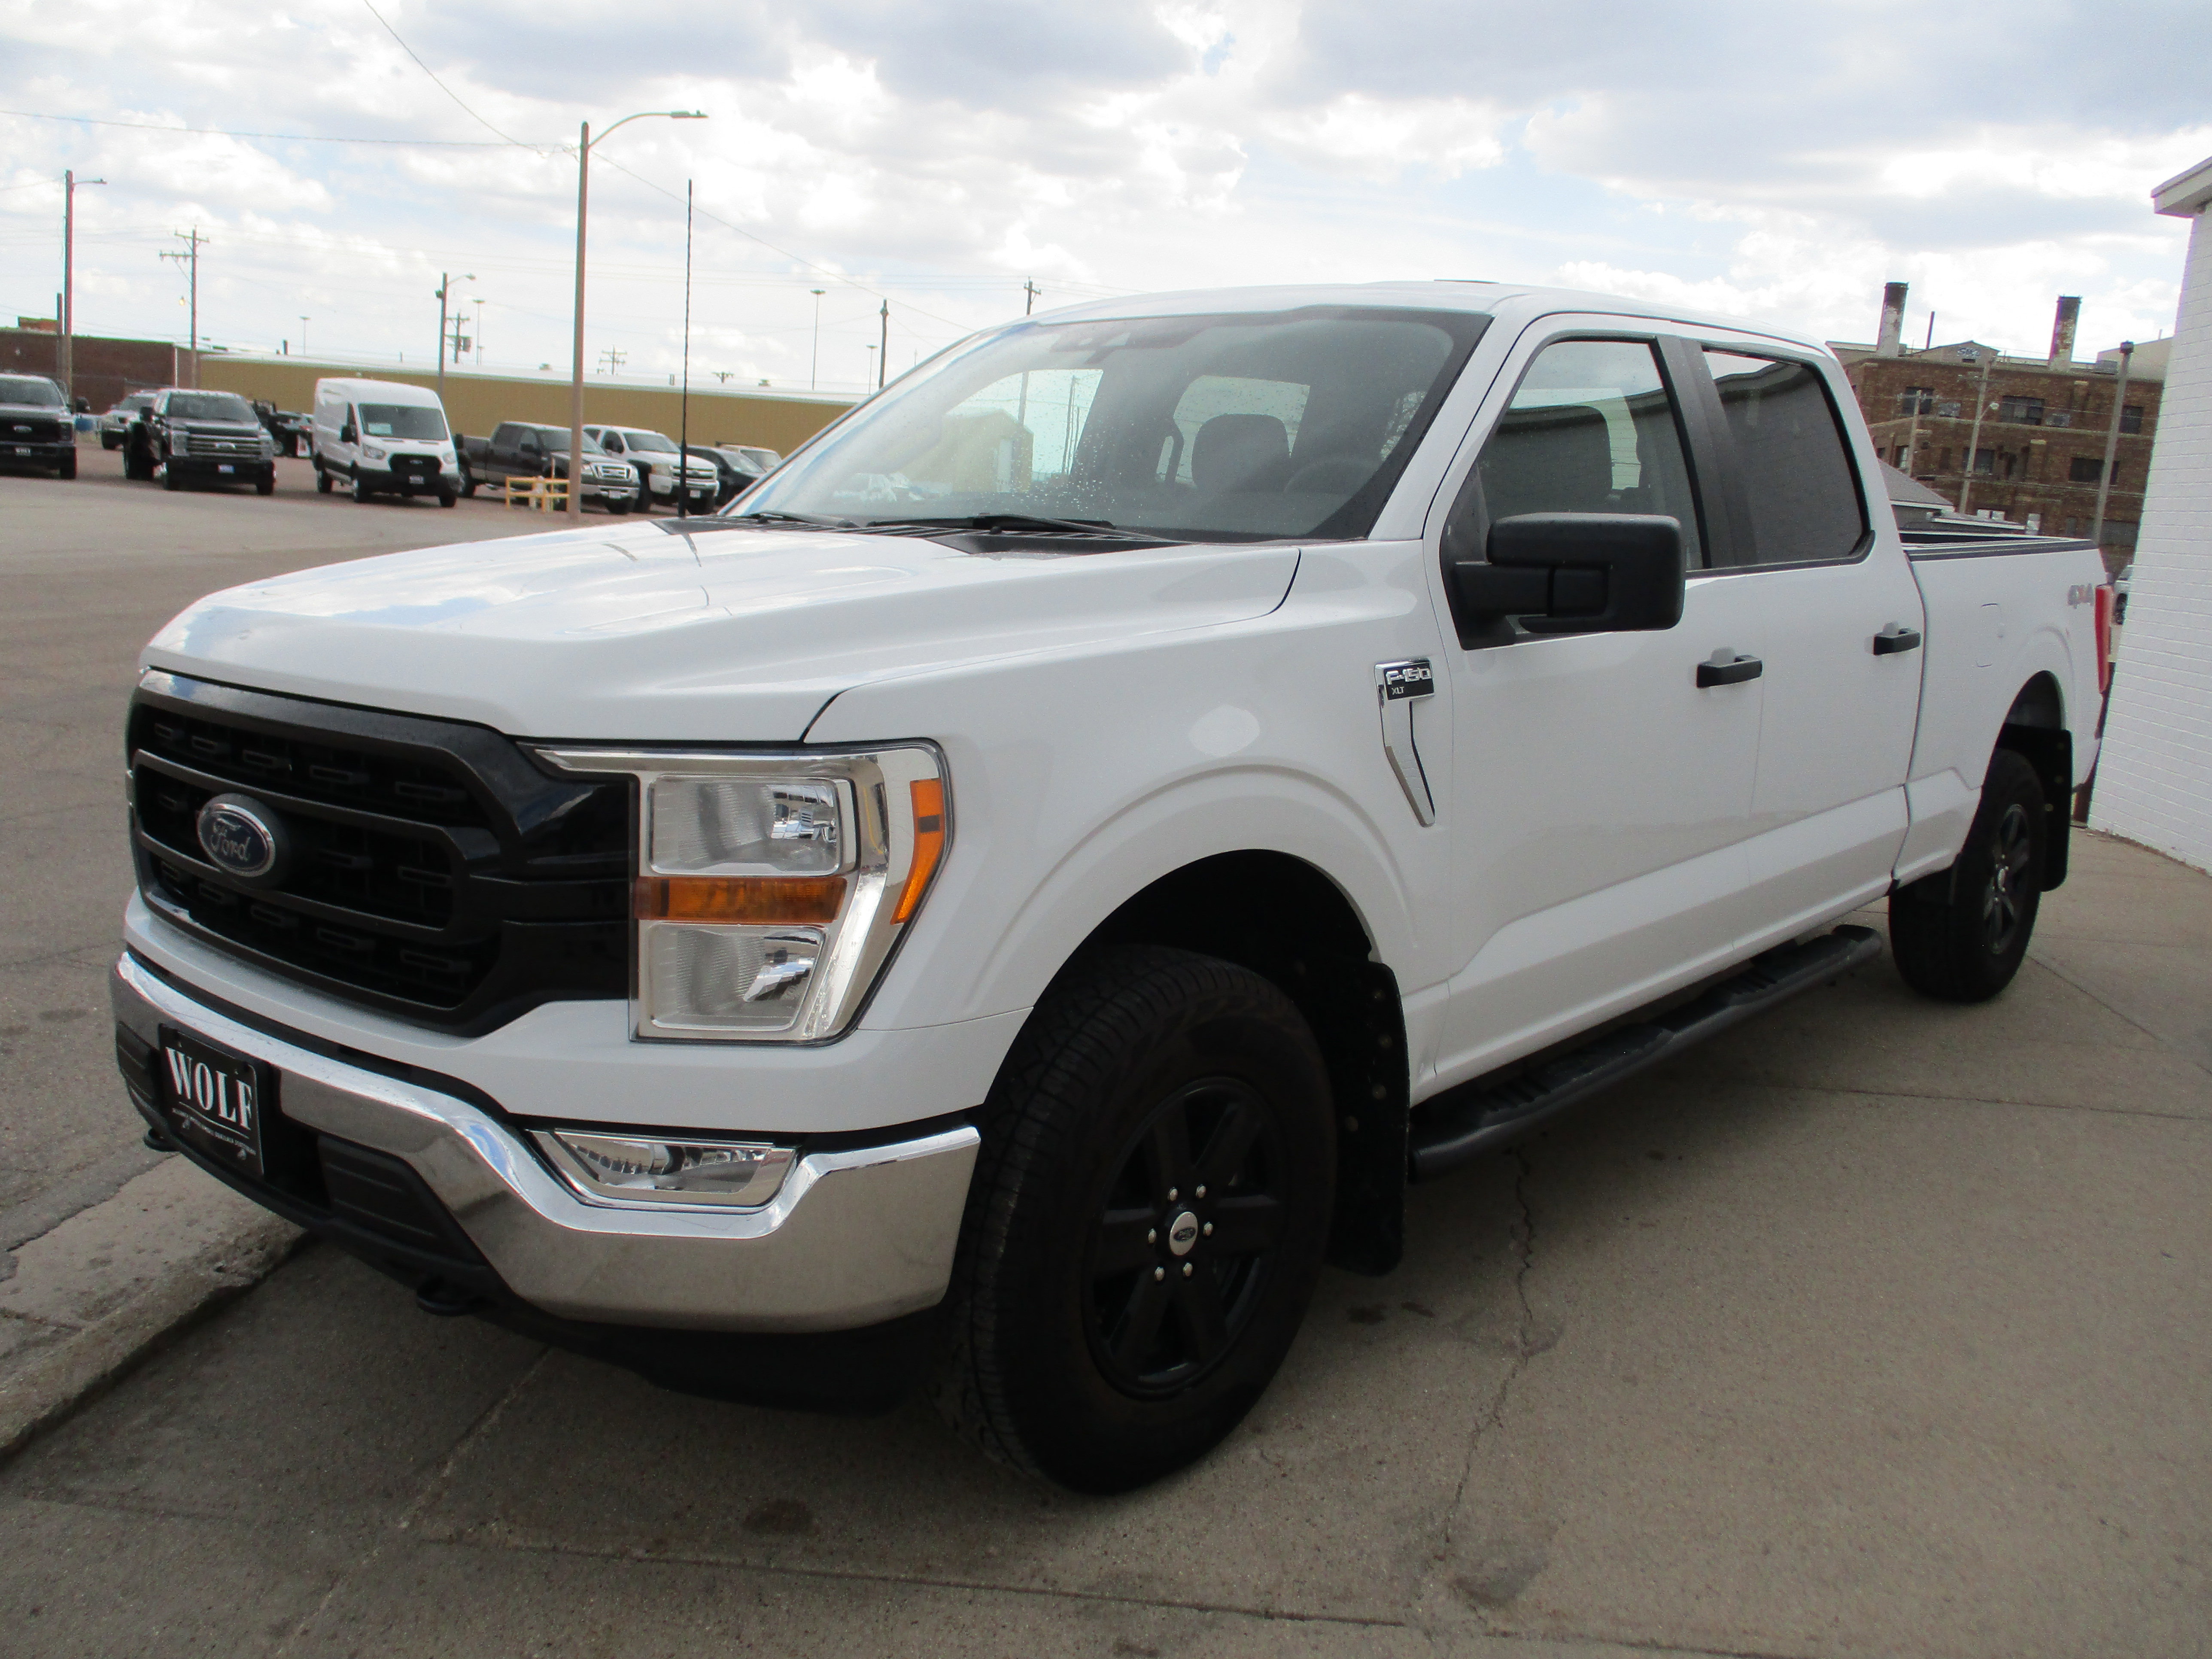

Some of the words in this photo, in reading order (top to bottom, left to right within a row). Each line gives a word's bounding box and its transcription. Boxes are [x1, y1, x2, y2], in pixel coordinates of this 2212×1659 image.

[1386, 667, 1432, 685] F-150
[1392, 686, 1404, 695] XLT
[210, 817, 251, 862] Ford
[166, 1046, 252, 1131] WOLF
